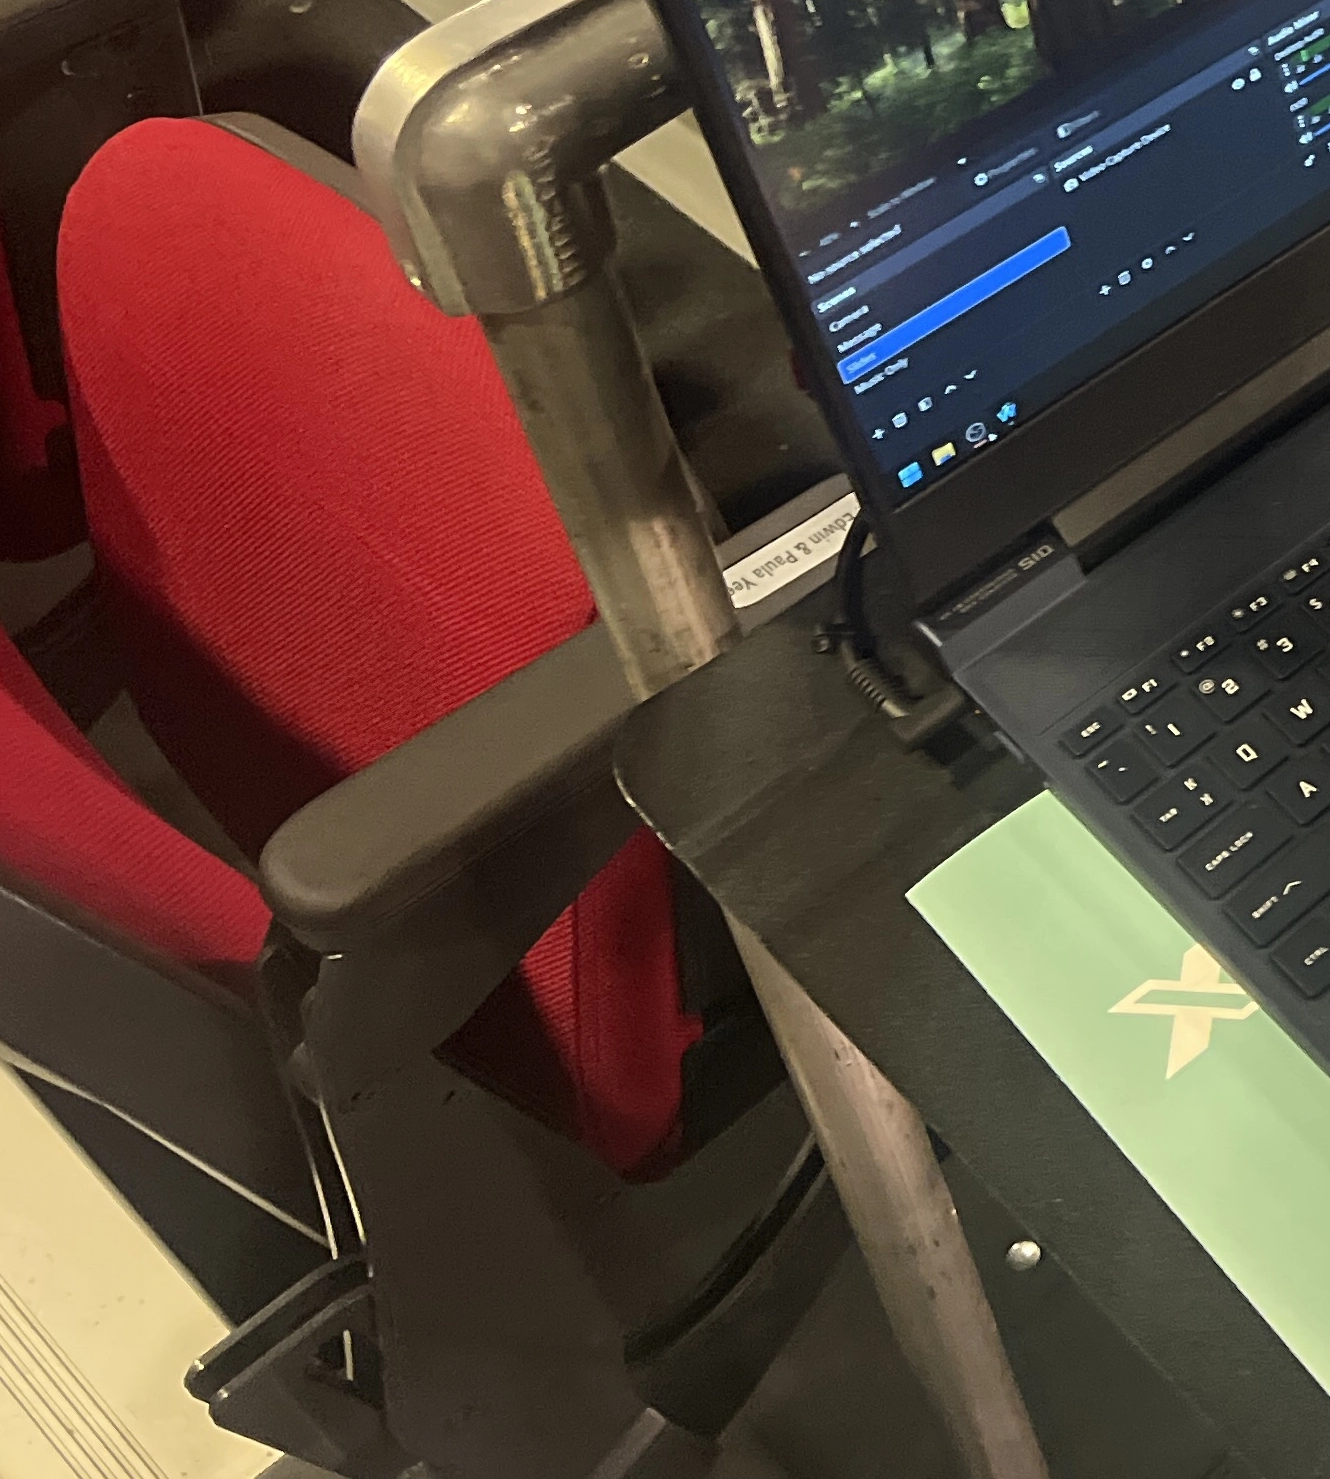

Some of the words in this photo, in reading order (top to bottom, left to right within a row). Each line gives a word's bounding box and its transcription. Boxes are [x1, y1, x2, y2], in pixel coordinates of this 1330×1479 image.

[794, 541, 812, 556] &
[752, 551, 799, 579] Paula
[1276, 637, 1294, 653] 3
[1221, 678, 1240, 695] 2
[1289, 698, 1313, 720] W
[1167, 723, 1181, 736] 1
[1299, 781, 1318, 798] A
